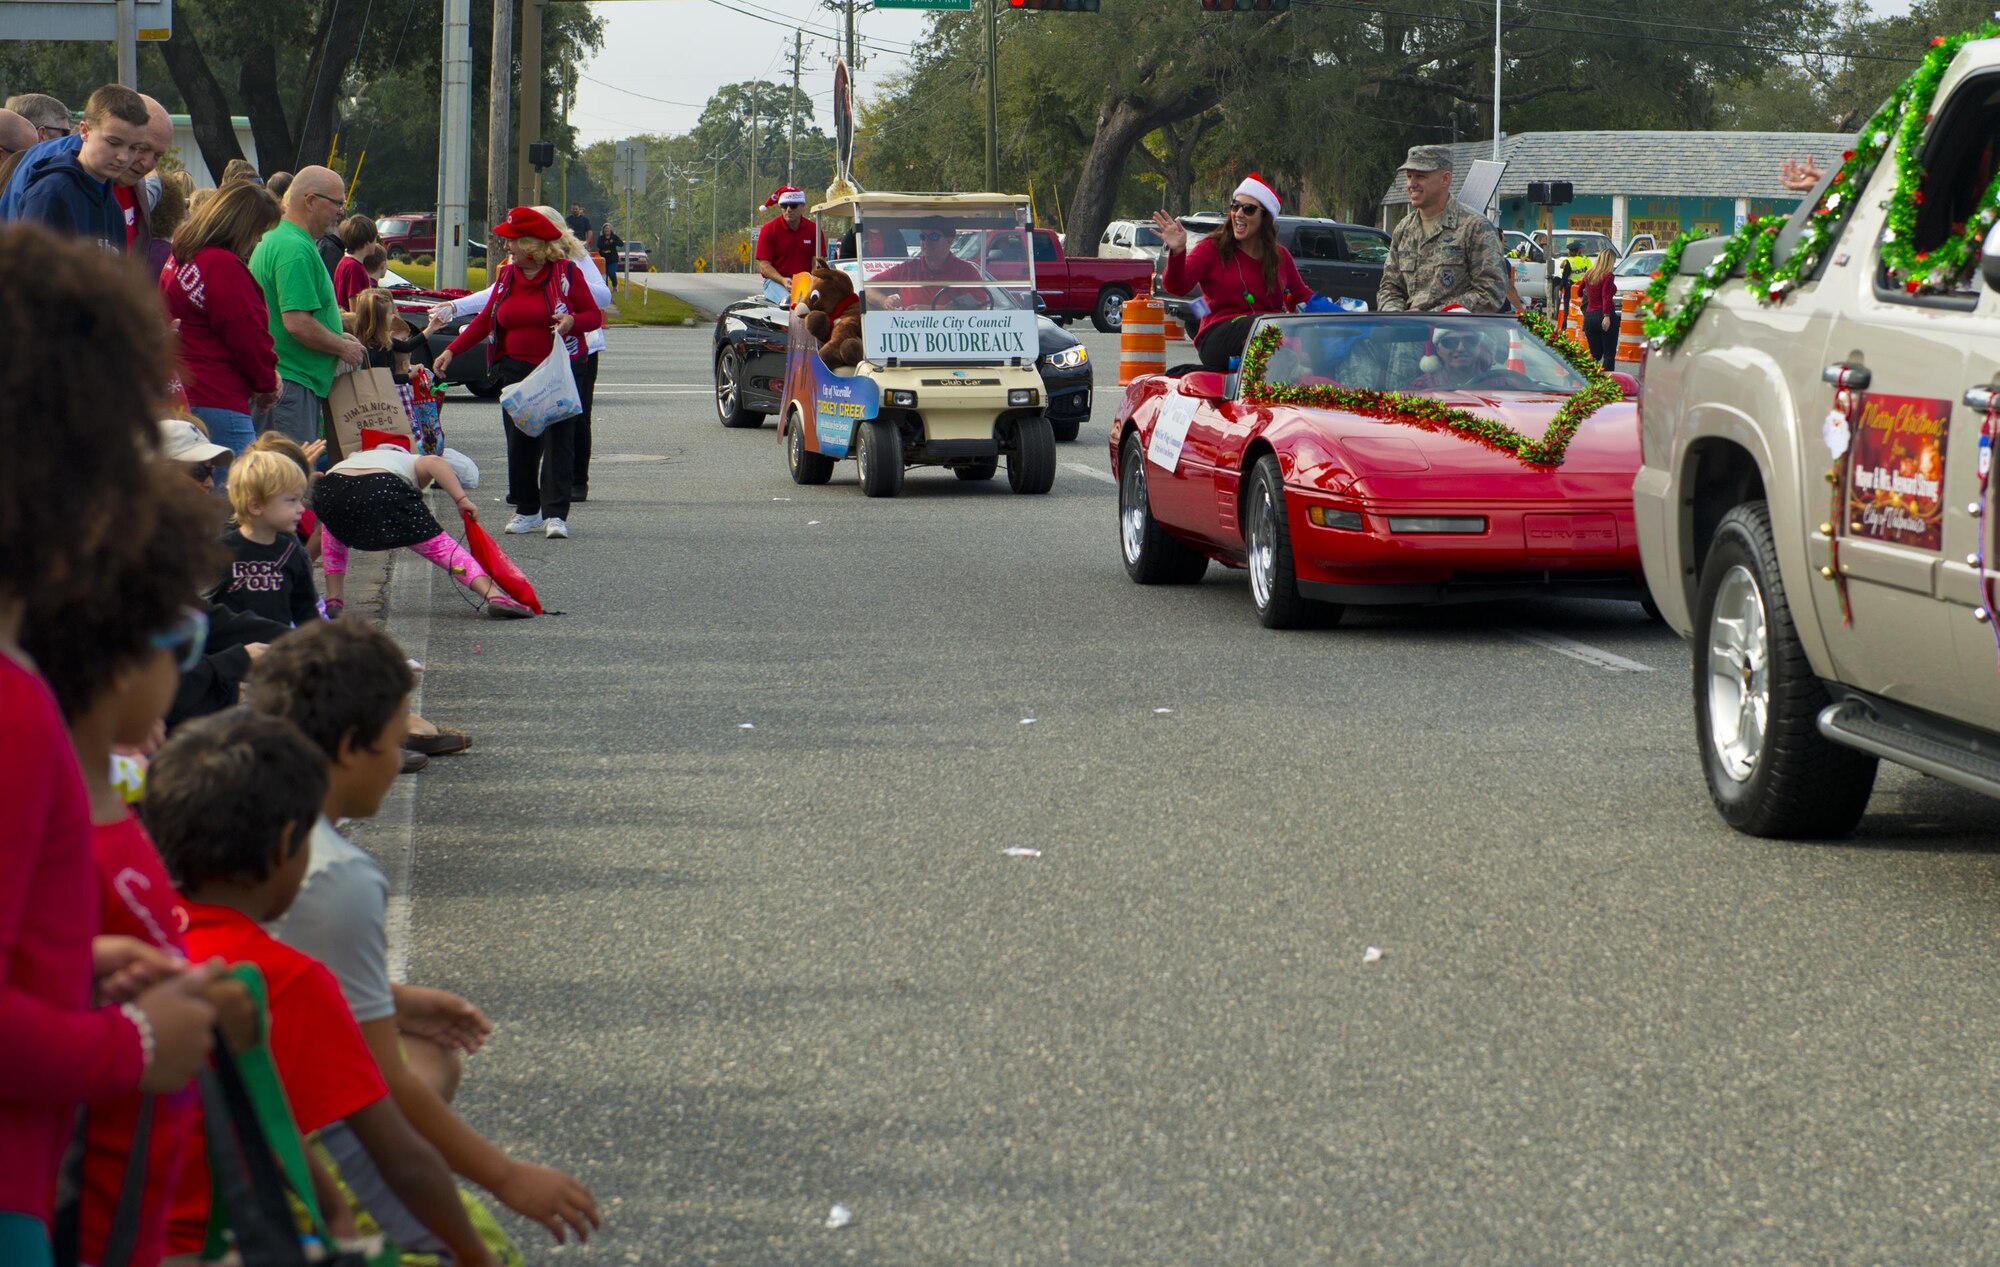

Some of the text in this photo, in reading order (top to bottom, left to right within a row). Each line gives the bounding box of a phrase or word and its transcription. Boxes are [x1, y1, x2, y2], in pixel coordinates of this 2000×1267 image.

[890, 315, 1012, 331] Niceville City Council
[880, 332, 1025, 353] JUDY BOUDREAUX
[833, 385, 852, 398] Niceville
[370, 402, 399, 415] NICK'S
[839, 402, 866, 419] CREEK
[356, 416, 393, 430] BAR-B-Q
[1858, 401, 1947, 444] Merry Christmas
[1862, 503, 1878, 535] City
[1530, 529, 1614, 539] CORVETTE
[232, 560, 281, 579] ROCK
[247, 575, 284, 592] OUT
